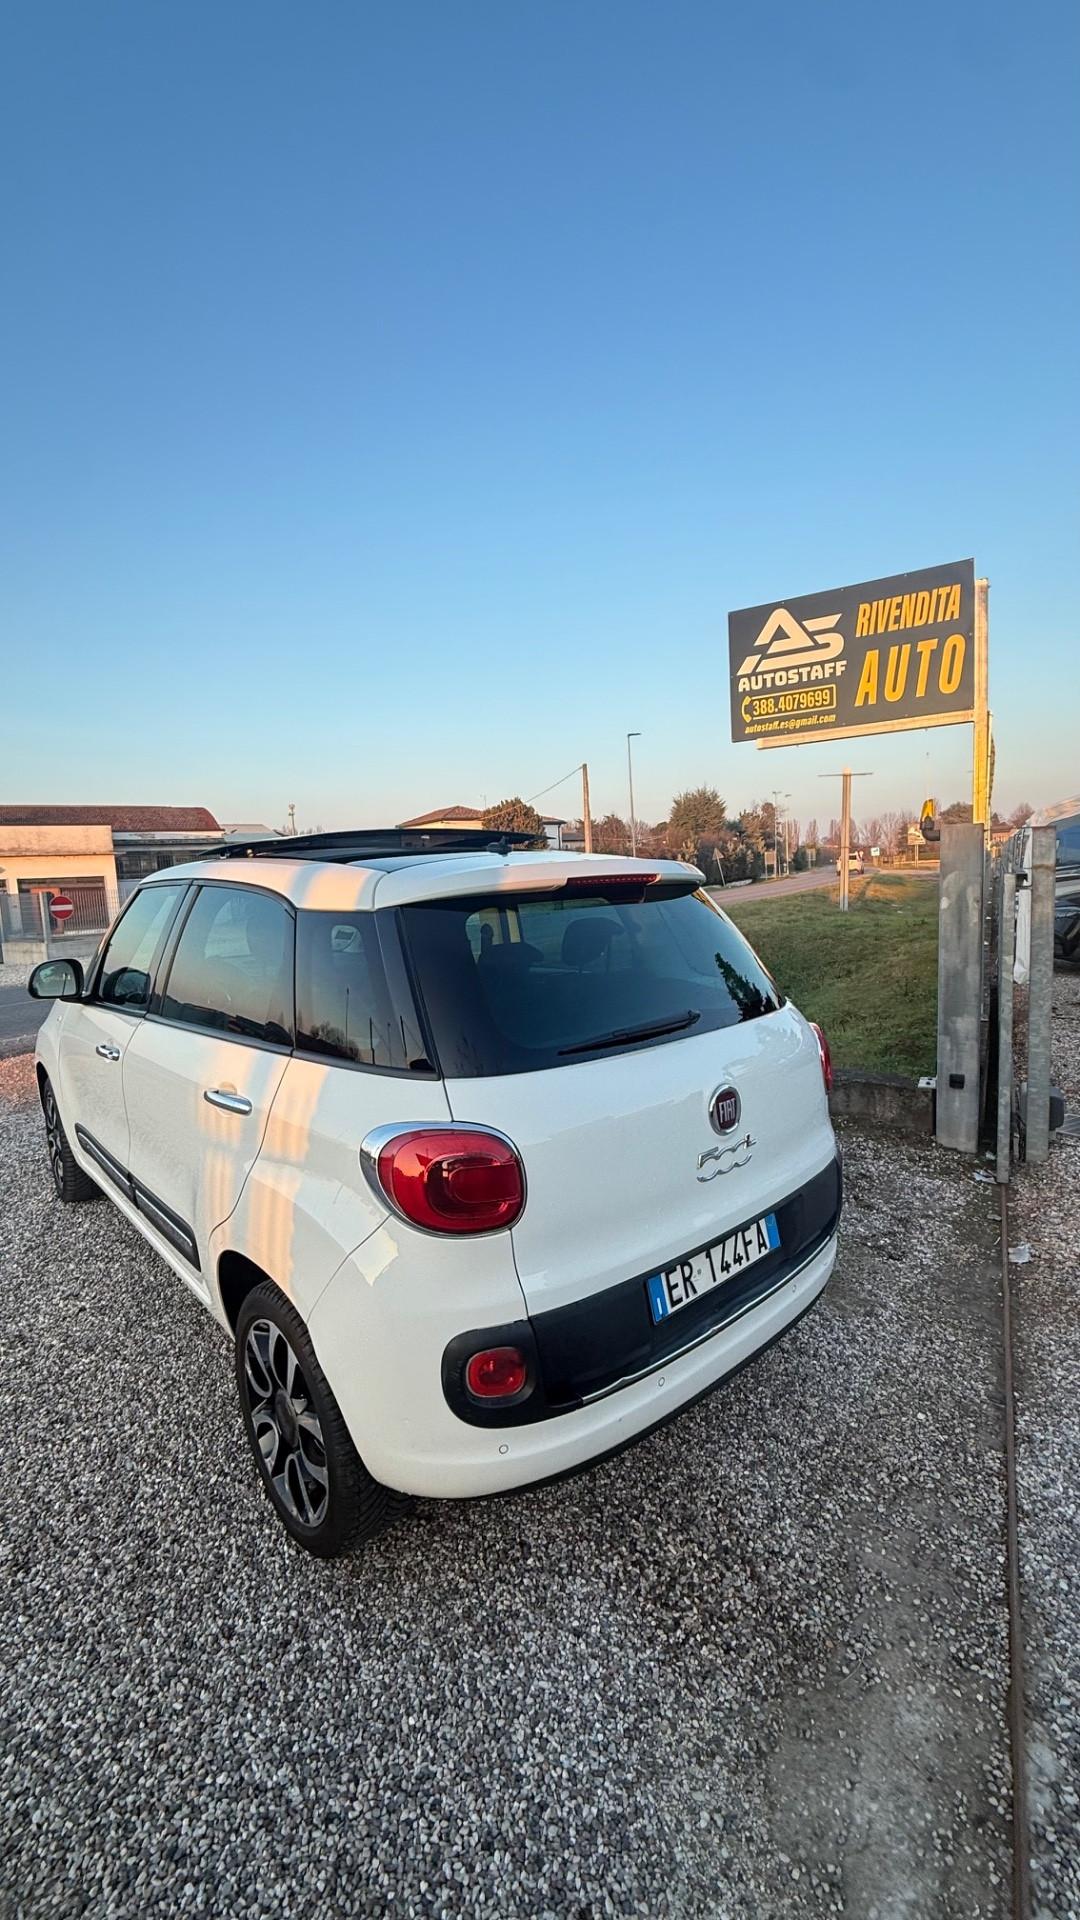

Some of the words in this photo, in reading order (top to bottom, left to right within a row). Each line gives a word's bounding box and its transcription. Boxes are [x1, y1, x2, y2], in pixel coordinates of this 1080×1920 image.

[855, 584, 961, 638] RIVENDITA
[738, 660, 848, 692] AUTOSTAFF
[854, 633, 966, 707] AUTO
[752, 689, 831, 716] 388.4079699
[744, 714, 836, 734] autostaff.es@gmail.com
[718, 1097, 736, 1123] FIAT
[664, 1261, 698, 1309] ER
[705, 1221, 768, 1283] 144FA
